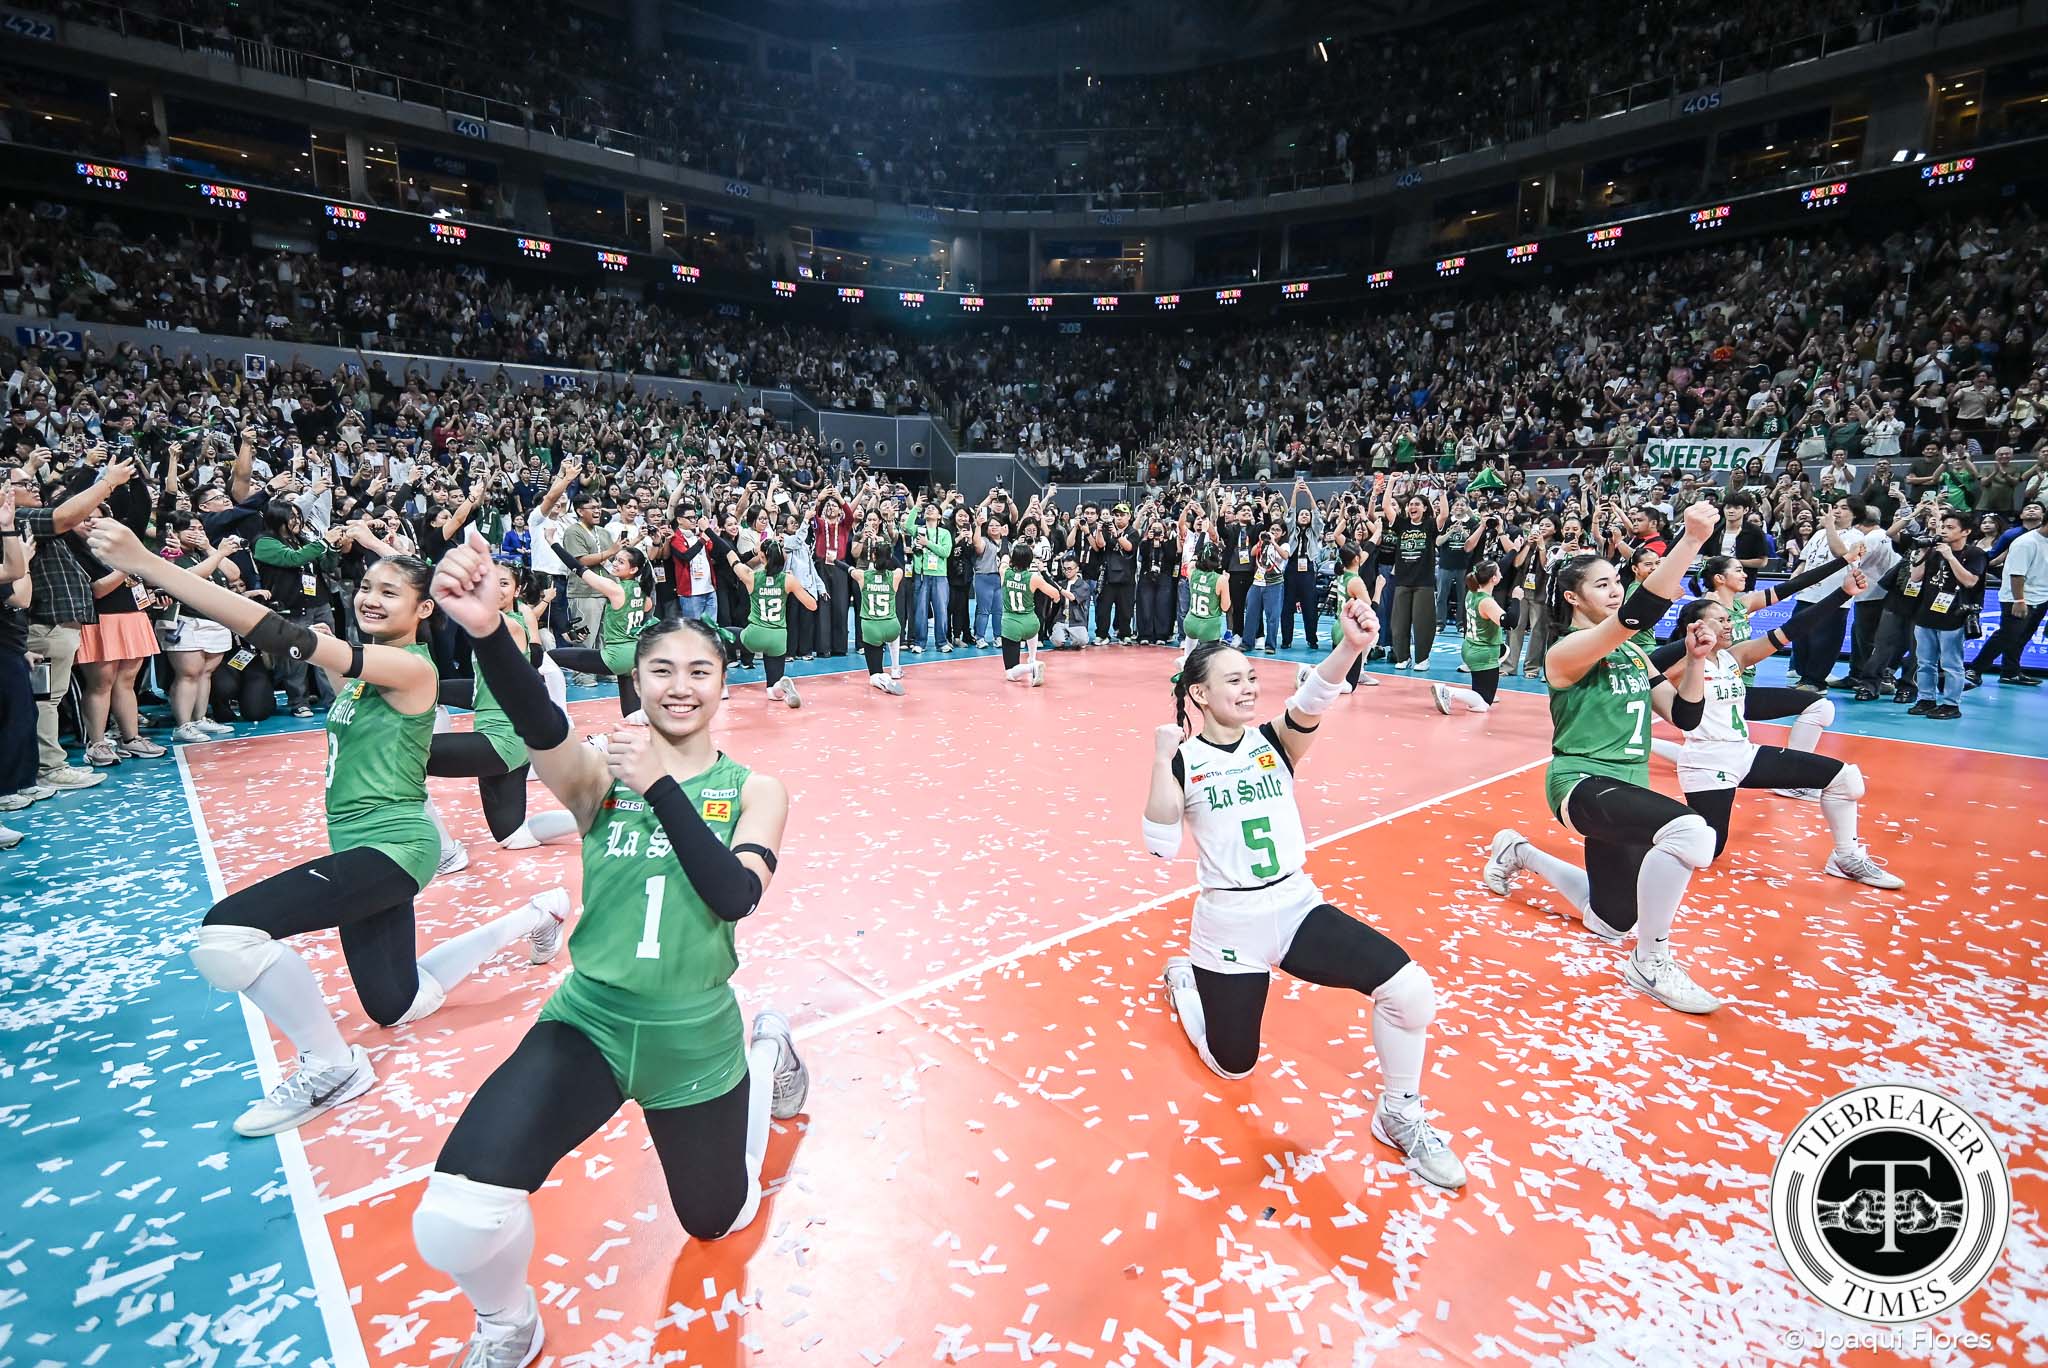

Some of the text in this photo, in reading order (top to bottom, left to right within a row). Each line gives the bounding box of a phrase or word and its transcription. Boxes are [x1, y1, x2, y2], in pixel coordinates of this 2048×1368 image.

[4, 14, 53, 40] 422
[1684, 93, 1721, 113] 405
[455, 120, 487, 138] 401
[76, 162, 128, 181] CASINO
[1922, 158, 1974, 178] CASINO
[86, 177, 121, 190] PLUS
[1397, 170, 1424, 188] 404
[1928, 174, 1964, 186] PLUS
[201, 183, 247, 201] CASINO
[726, 182, 750, 198] 402
[1800, 182, 1848, 202] CASINO
[210, 198, 241, 208] PLUS
[1808, 197, 1838, 209] PLUS
[326, 204, 366, 221] CASINO
[1690, 206, 1730, 224] CASINO
[333, 218, 360, 228] PLUS
[1695, 218, 1722, 230] PLUS
[436, 235, 461, 246] PLUS
[1592, 238, 1616, 249] PLUS
[524, 250, 546, 259] PLUS
[1511, 254, 1532, 264] PLUS
[603, 262, 624, 272] PLUS
[1440, 267, 1460, 277] PLUS
[677, 274, 696, 283] PLUS
[1370, 280, 1388, 289] PLUS
[146, 319, 170, 331] NU
[24, 328, 74, 350] 122
[758, 598, 782, 622] 12
[867, 594, 890, 617] 15
[1008, 591, 1026, 612] 11
[1190, 593, 1210, 616] 16
[1608, 672, 1650, 695] La Sall
[1713, 685, 1729, 701] La
[1626, 700, 1646, 744] 7
[1732, 704, 1748, 738] 4
[1258, 754, 1274, 766] F2
[1716, 771, 1726, 782] 4
[1204, 774, 1284, 812] La Salle
[616, 800, 644, 810] ICTSI
[706, 803, 728, 815] F2
[604, 821, 640, 858] La
[1242, 816, 1280, 878] 5
[636, 875, 666, 959] 1
